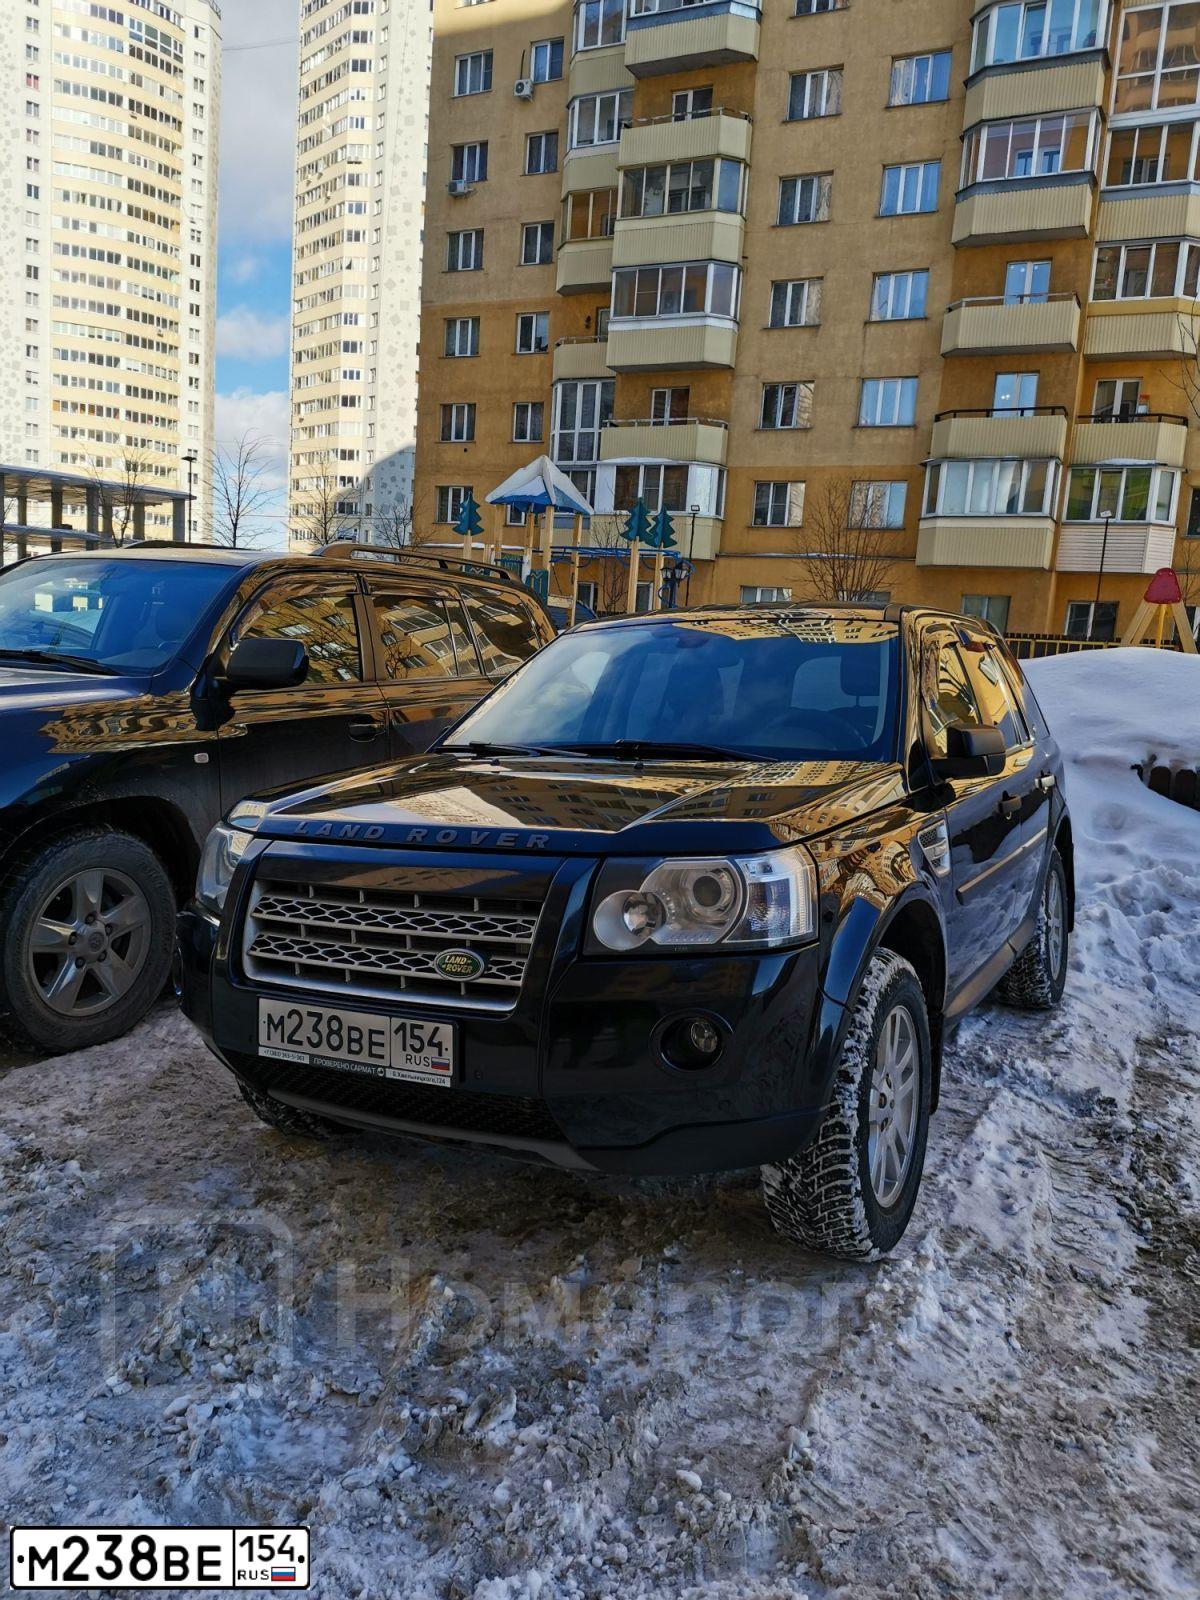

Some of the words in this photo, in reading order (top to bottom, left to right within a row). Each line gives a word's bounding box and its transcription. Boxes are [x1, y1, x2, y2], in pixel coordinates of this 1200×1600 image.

[293, 821, 385, 840] LAND
[406, 828, 550, 849] ROVER
[445, 963, 473, 974] ROVER
[394, 1021, 443, 1057] 154
[405, 1053, 430, 1068] RUS
